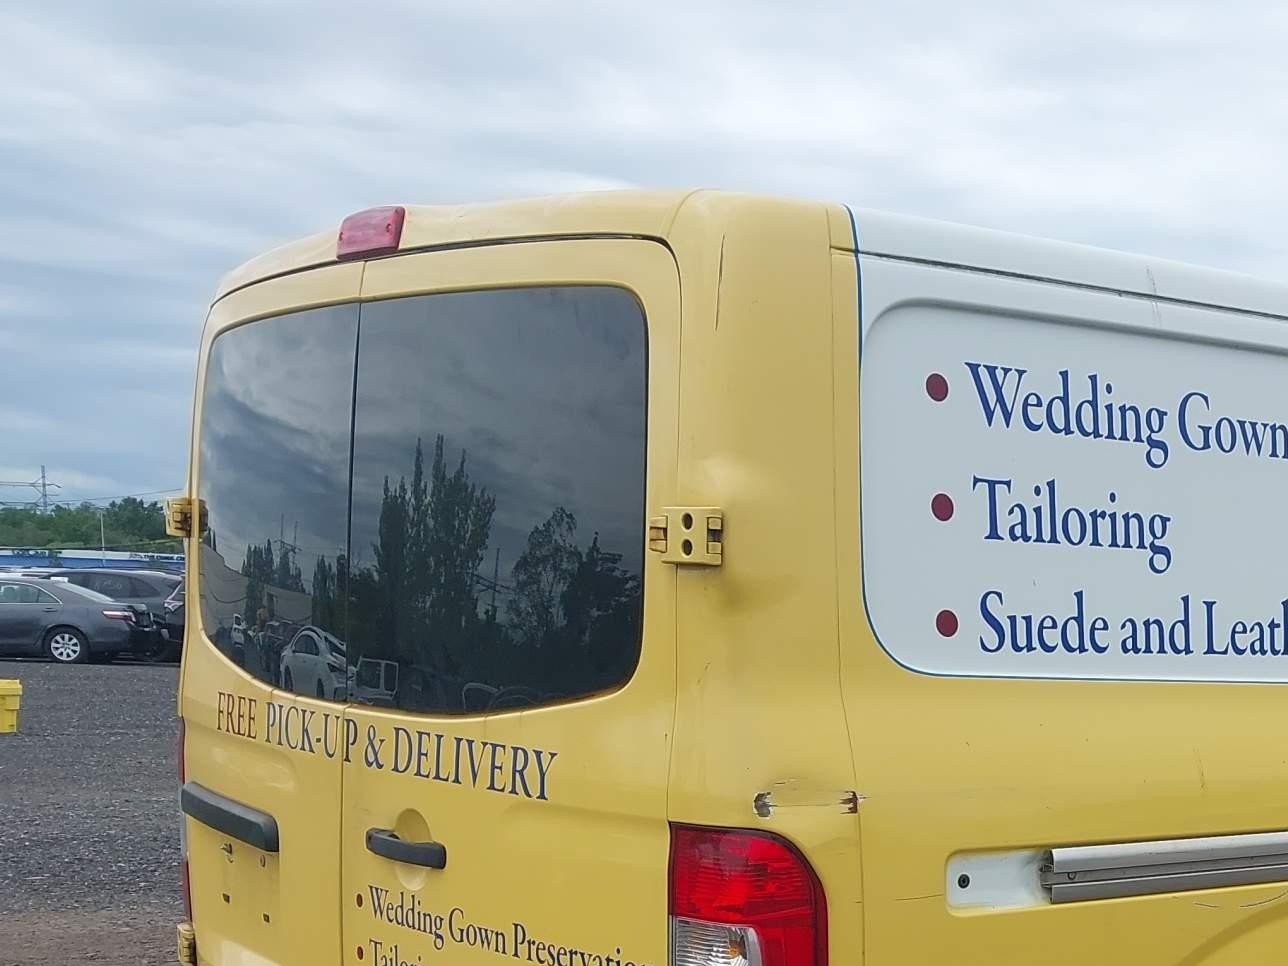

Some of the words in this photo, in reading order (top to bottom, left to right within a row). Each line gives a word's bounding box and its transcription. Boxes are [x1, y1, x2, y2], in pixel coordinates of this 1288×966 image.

[964, 361, 1168, 468] Wedding
[973, 476, 1172, 574] Tailoring
[979, 590, 1109, 655] Suede
[1120, 595, 1194, 656] and
[216, 691, 257, 740] FREE
[264, 701, 358, 764] PICK-UP
[364, 725, 385, 770] &
[391, 726, 558, 800] DELIVERY
[368, 884, 444, 950] Wedding
[448, 908, 507, 956] Gown
